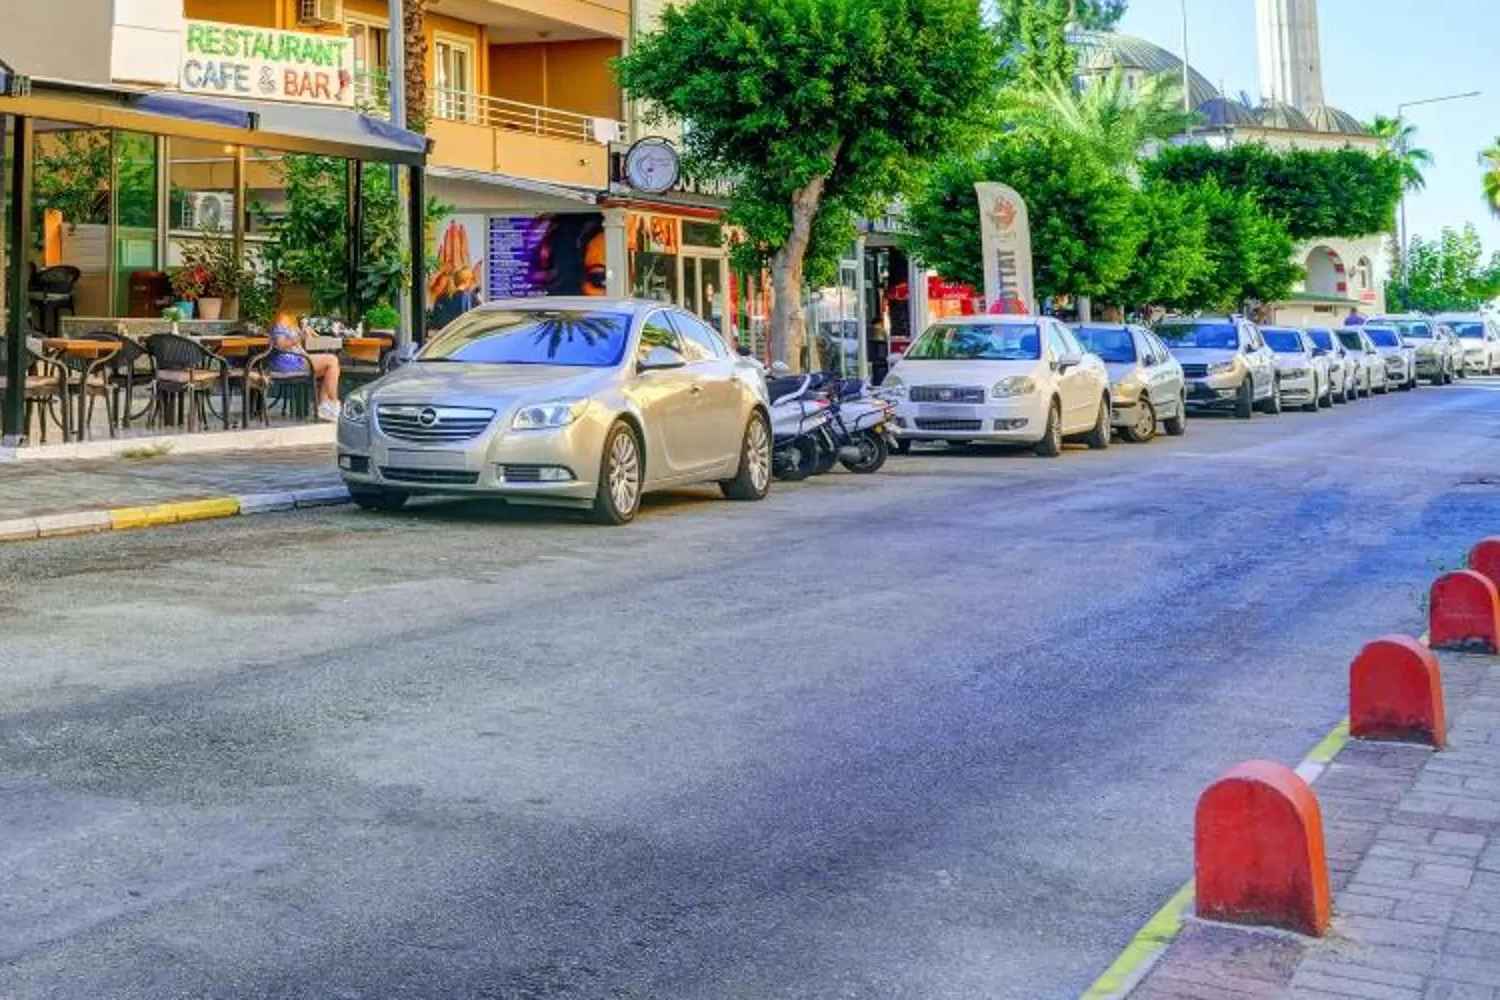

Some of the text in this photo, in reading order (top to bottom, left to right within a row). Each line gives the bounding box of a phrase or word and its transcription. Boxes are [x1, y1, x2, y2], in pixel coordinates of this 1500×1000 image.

[186, 23, 349, 67] RESTAURANT
[183, 59, 331, 101] CAFE & BAR
